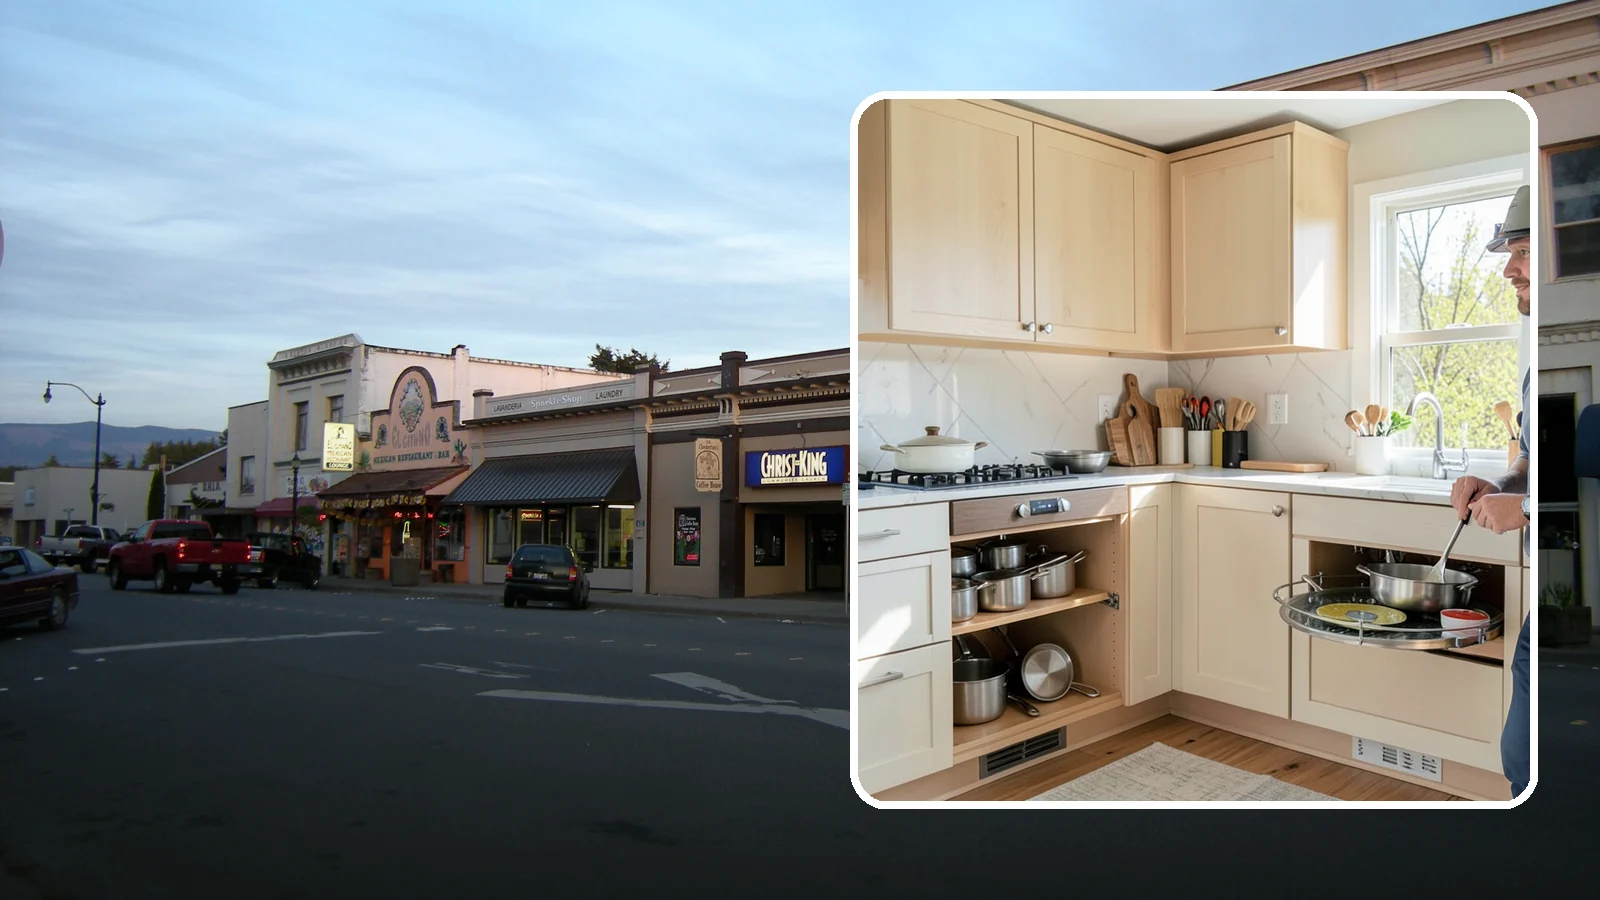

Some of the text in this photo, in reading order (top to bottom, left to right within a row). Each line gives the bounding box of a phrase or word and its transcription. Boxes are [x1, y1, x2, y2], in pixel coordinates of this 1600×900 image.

[530, 394, 582, 408] Sparkle Shop
[595, 388, 623, 400] LAUNDRY
[493, 401, 523, 413] LAVANDERIA
[374, 454, 396, 464] MEXICAN
[397, 451, 433, 462] RESTAURANT
[438, 450, 450, 459] BAR
[760, 450, 827, 478] CHRIST KING
